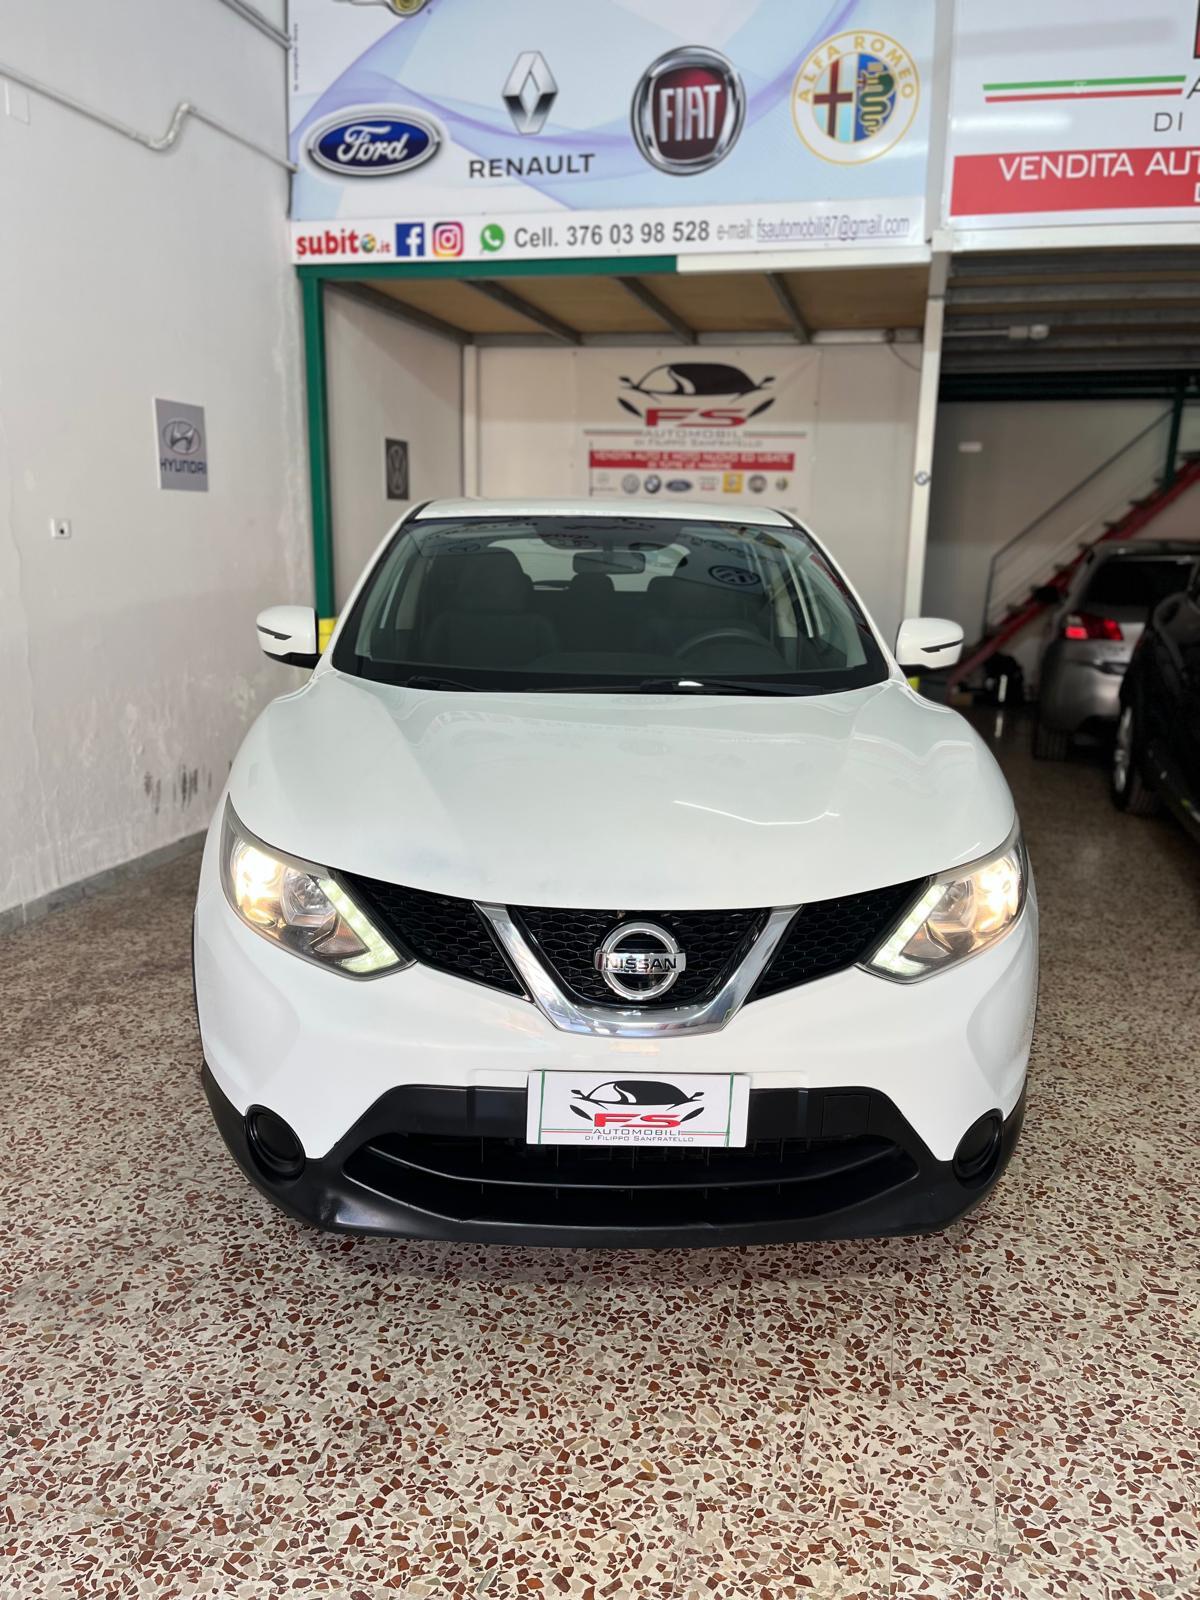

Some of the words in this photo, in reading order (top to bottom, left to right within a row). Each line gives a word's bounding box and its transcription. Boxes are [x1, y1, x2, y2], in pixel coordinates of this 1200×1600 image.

[798, 45, 841, 103] ALFA
[853, 35, 915, 99] ROMEO
[659, 85, 722, 142] FIAT
[1153, 112, 1183, 132] DI
[337, 125, 408, 162] Ford
[469, 154, 595, 178] RENAULT
[999, 153, 1134, 181] VENDITA
[514, 227, 558, 248] Cell.
[567, 225, 603, 246] 376
[609, 223, 634, 244] 03
[640, 222, 665, 243] 98
[672, 220, 710, 242] 528
[717, 218, 753, 240] e-mail:
[645, 408, 748, 427] FS
[605, 957, 677, 970] NISSAN
[593, 1128, 681, 1137] AUTOMOBILI
[594, 1113, 681, 1128] FS
